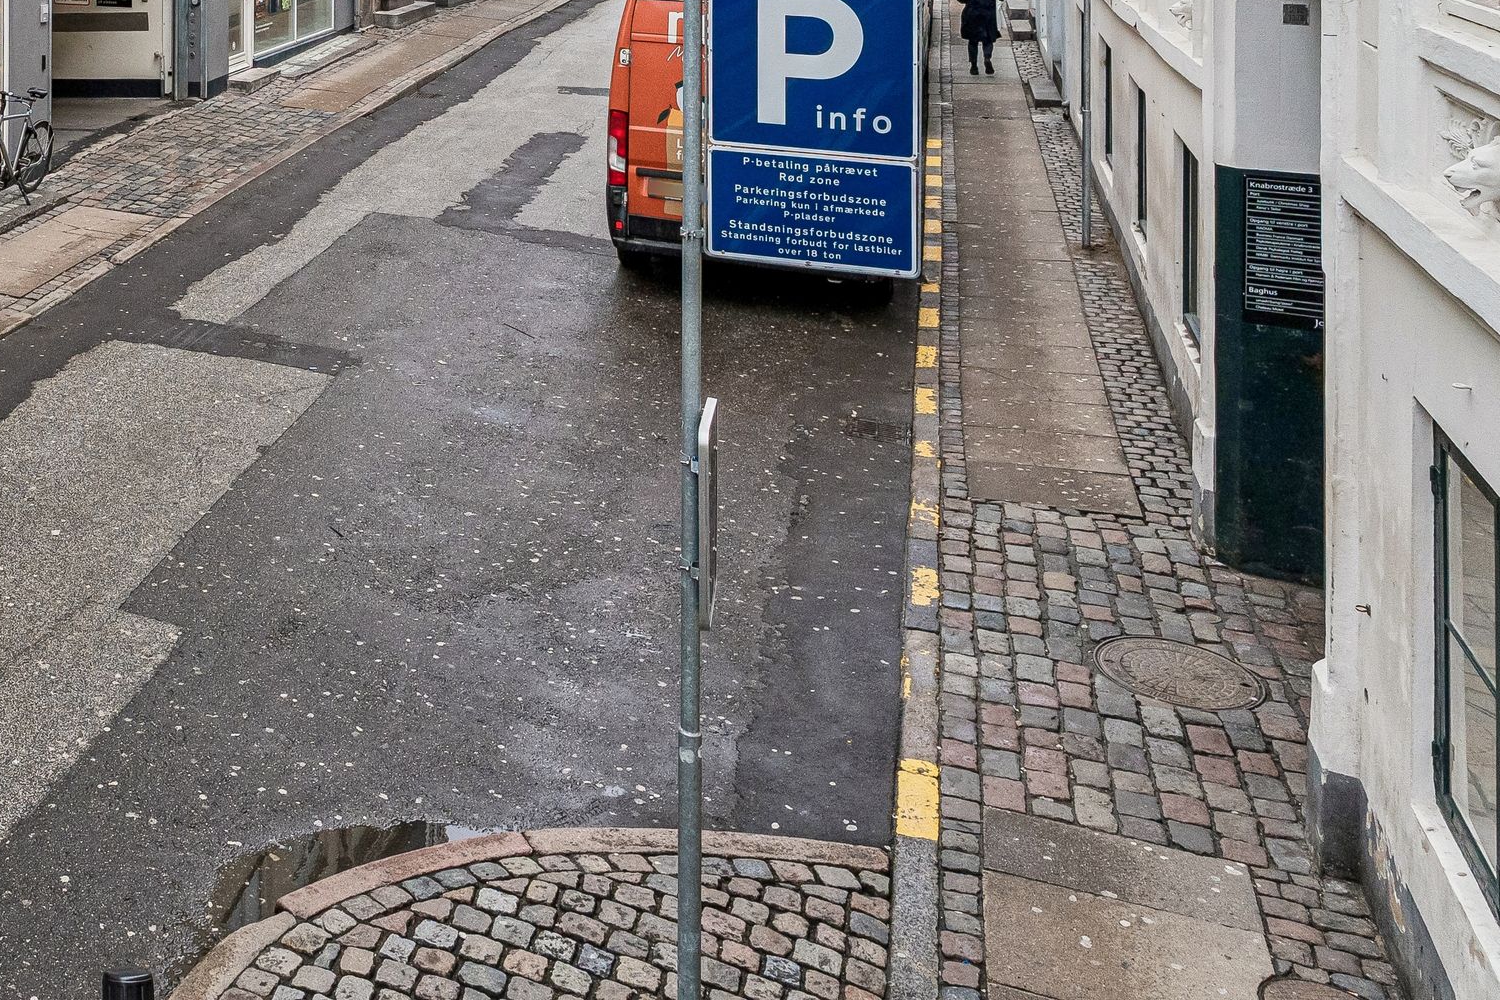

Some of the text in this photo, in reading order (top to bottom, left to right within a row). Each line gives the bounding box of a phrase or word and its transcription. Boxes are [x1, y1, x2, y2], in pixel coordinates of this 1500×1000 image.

[816, 104, 892, 134] info
[743, 156, 878, 177] P-betaling påkrævet
[779, 172, 840, 186] Rød zone
[1249, 181, 1306, 193] Knabrostræde
[734, 184, 887, 207] Parkeringsforbudszone
[736, 195, 885, 217] Parkering kun i afmærkede
[783, 210, 836, 223] P-pladser
[729, 219, 893, 244] Standsningsforbudszone
[721, 230, 903, 256] Standsning forbudt for lastbiler
[778, 247, 842, 260] over 18 ton
[1248, 264, 1269, 272] Opgang
[1248, 286, 1278, 296] Baghus
